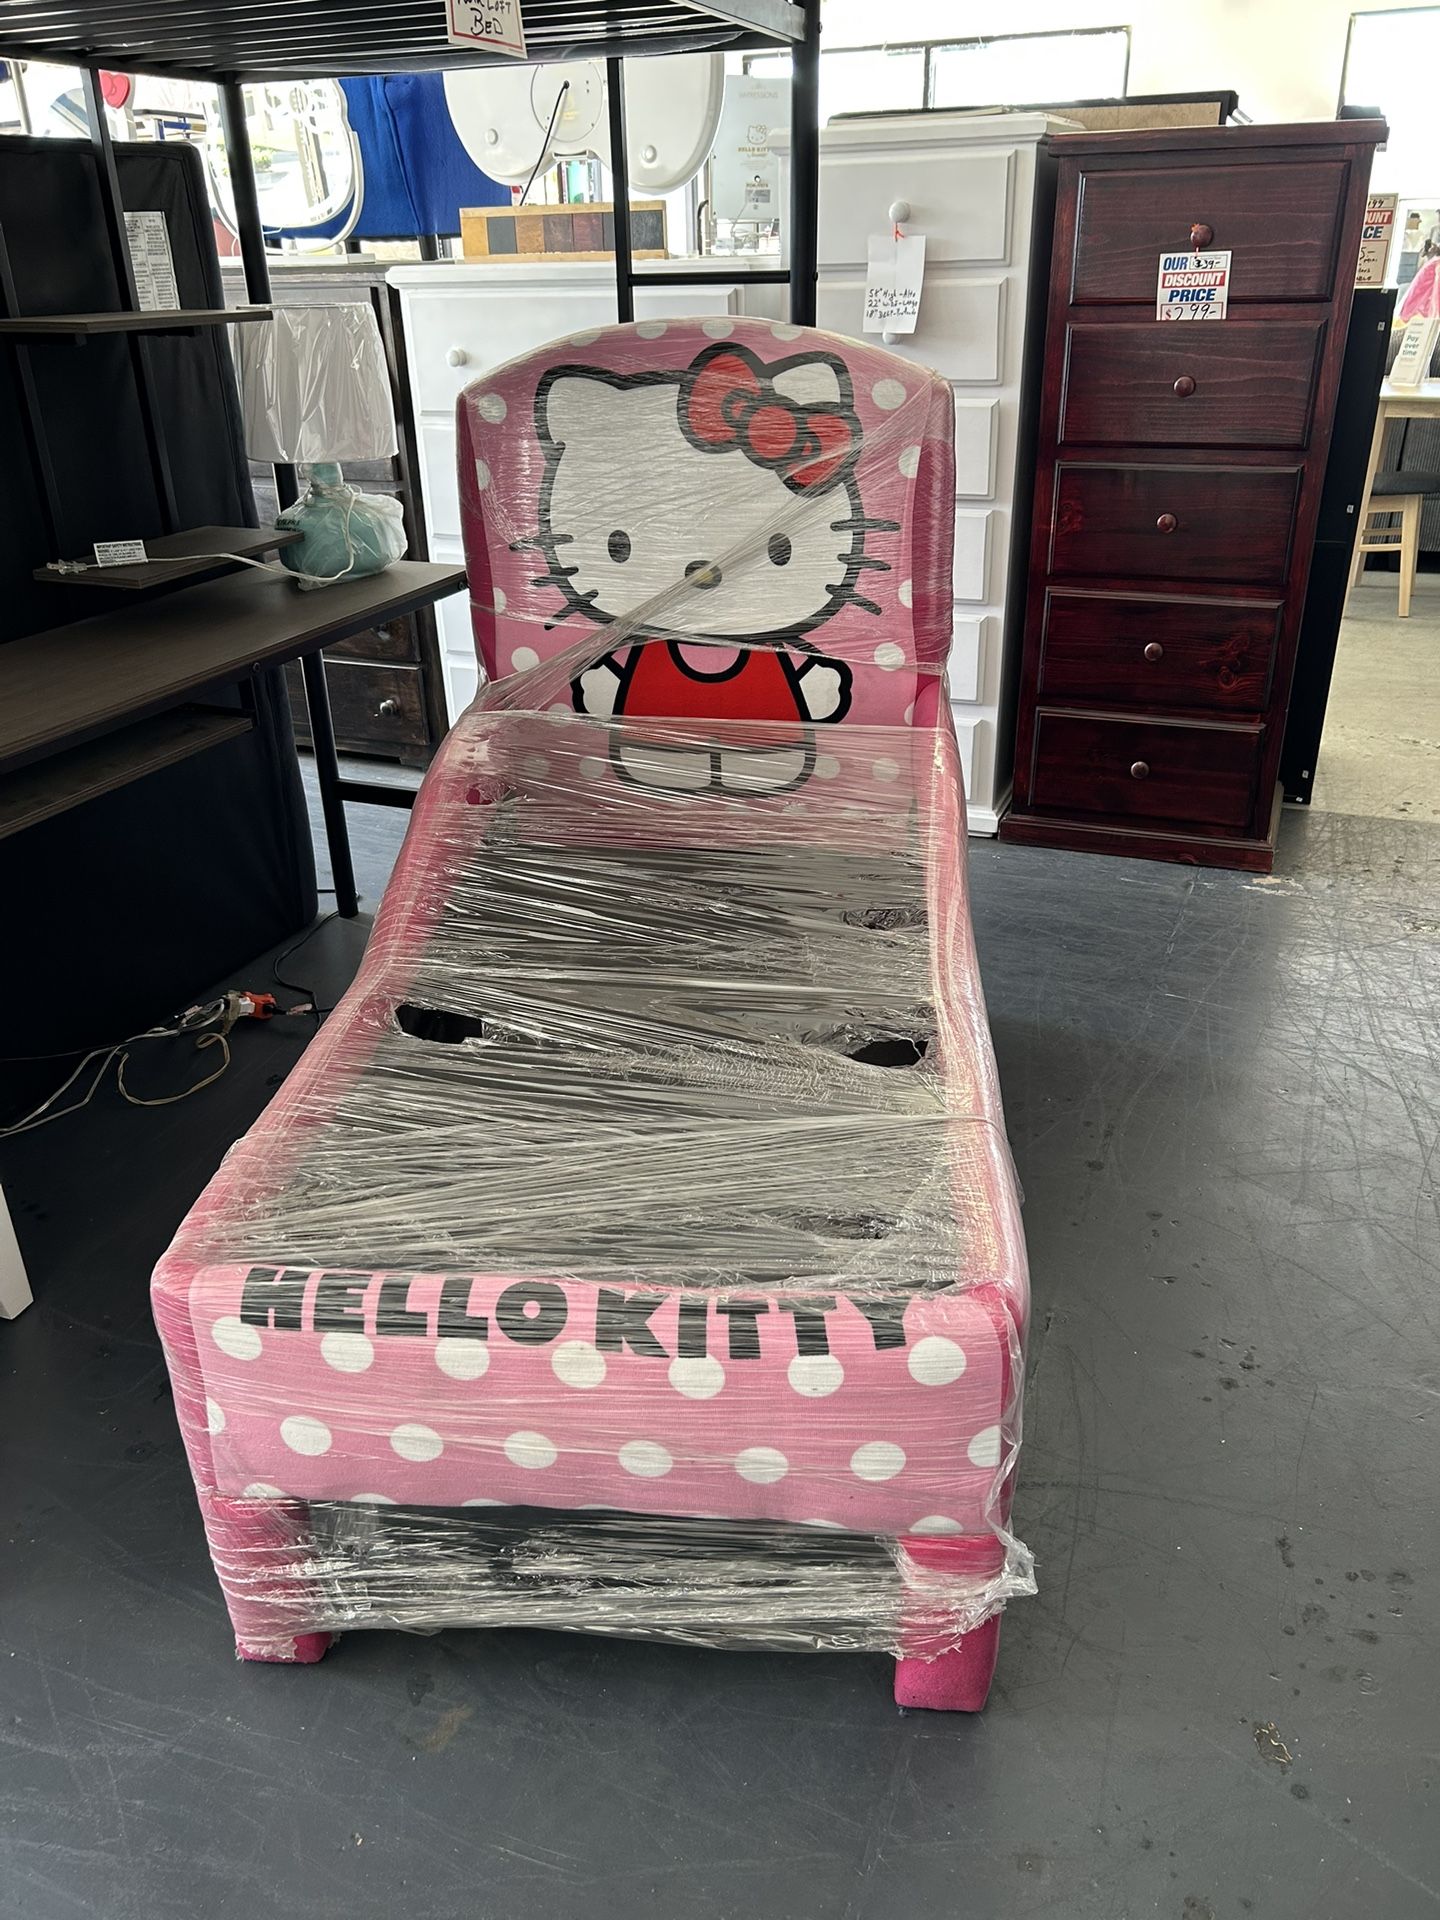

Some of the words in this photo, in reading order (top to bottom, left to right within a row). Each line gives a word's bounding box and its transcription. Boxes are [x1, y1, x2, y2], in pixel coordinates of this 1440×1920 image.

[470, 7, 503, 36] BED
[1163, 256, 1189, 271] OUR
[1164, 272, 1224, 287] DISCOUNT
[1168, 288, 1217, 303] PRICE
[1407, 335, 1419, 343] Pay
[239, 1267, 569, 1346] HELLO
[595, 1287, 907, 1359] KITTY
